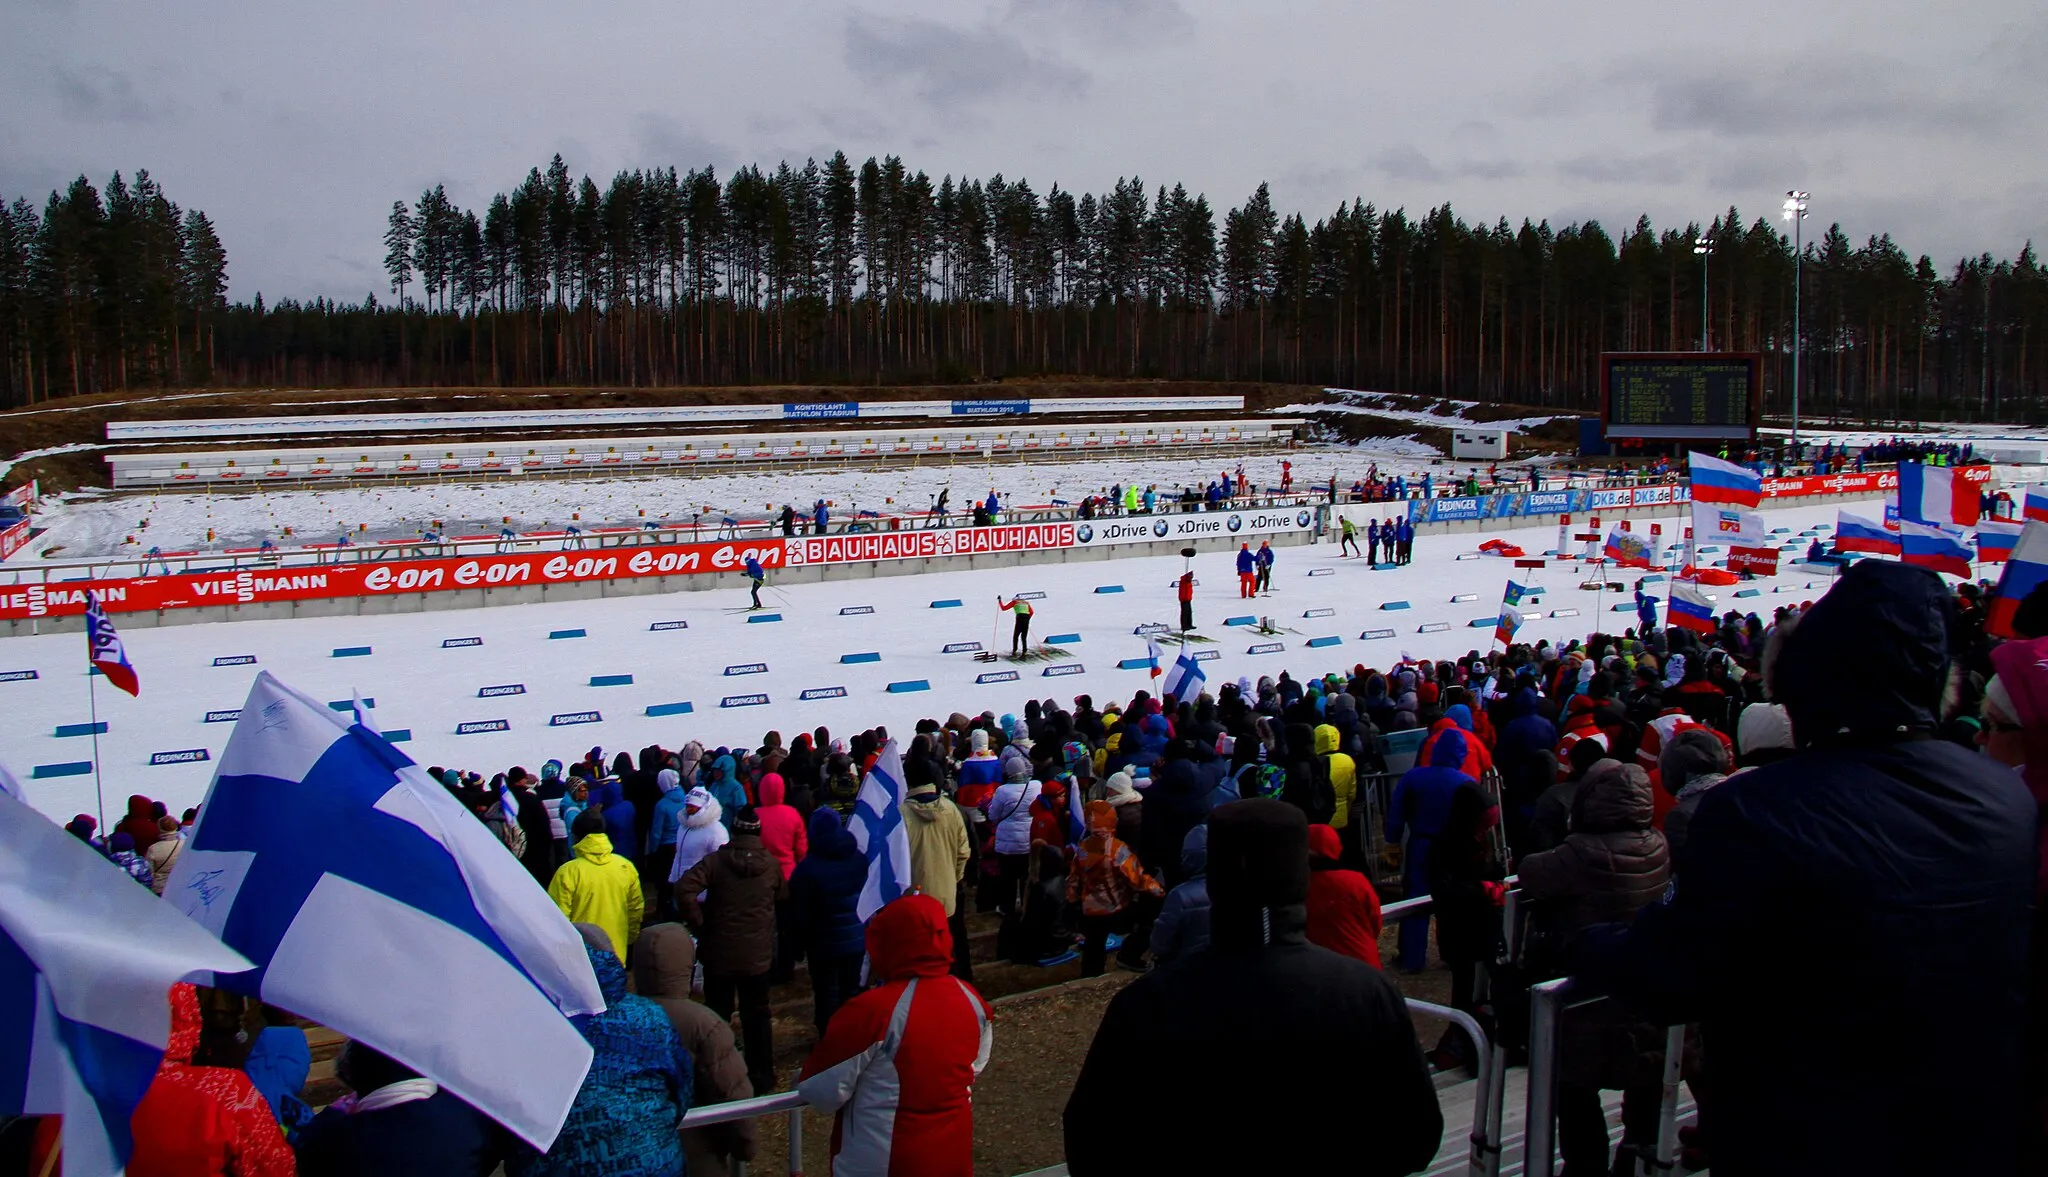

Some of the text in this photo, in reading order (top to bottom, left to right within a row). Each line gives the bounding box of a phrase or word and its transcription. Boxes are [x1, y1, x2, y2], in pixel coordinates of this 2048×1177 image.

[1823, 476, 1867, 491] VIESSMANN
[1530, 493, 1567, 506] ERDINGER
[1593, 492, 1630, 506] DKB.de
[1634, 489, 1670, 503] DKB.de
[1437, 499, 1477, 512] ERDINGER
[1102, 514, 1290, 539] xDrive xDrive xDrive
[809, 526, 1073, 561] BAUHAUS BAUHAUS
[1729, 553, 1776, 566] VIESSMANN
[0, 572, 327, 616] IESSMANN VIESSMANN
[446, 637, 476, 646] ERDINGER
[948, 642, 973, 651] ERDINGER
[216, 657, 248, 666] ERDINGER
[730, 664, 758, 674] ERDINGER
[1048, 666, 1076, 676] ERDINGER
[0, 671, 28, 680] RDINGER
[982, 672, 1011, 682] ERDINGER
[482, 686, 514, 696] ERDINGER
[806, 686, 837, 698] ERDINGER
[726, 695, 759, 706] ERDINGER
[209, 711, 240, 721] ERDINGE
[555, 711, 590, 723] ERDINGER
[461, 721, 498, 731] ERDINGER
[156, 751, 196, 762] ERDINGER
